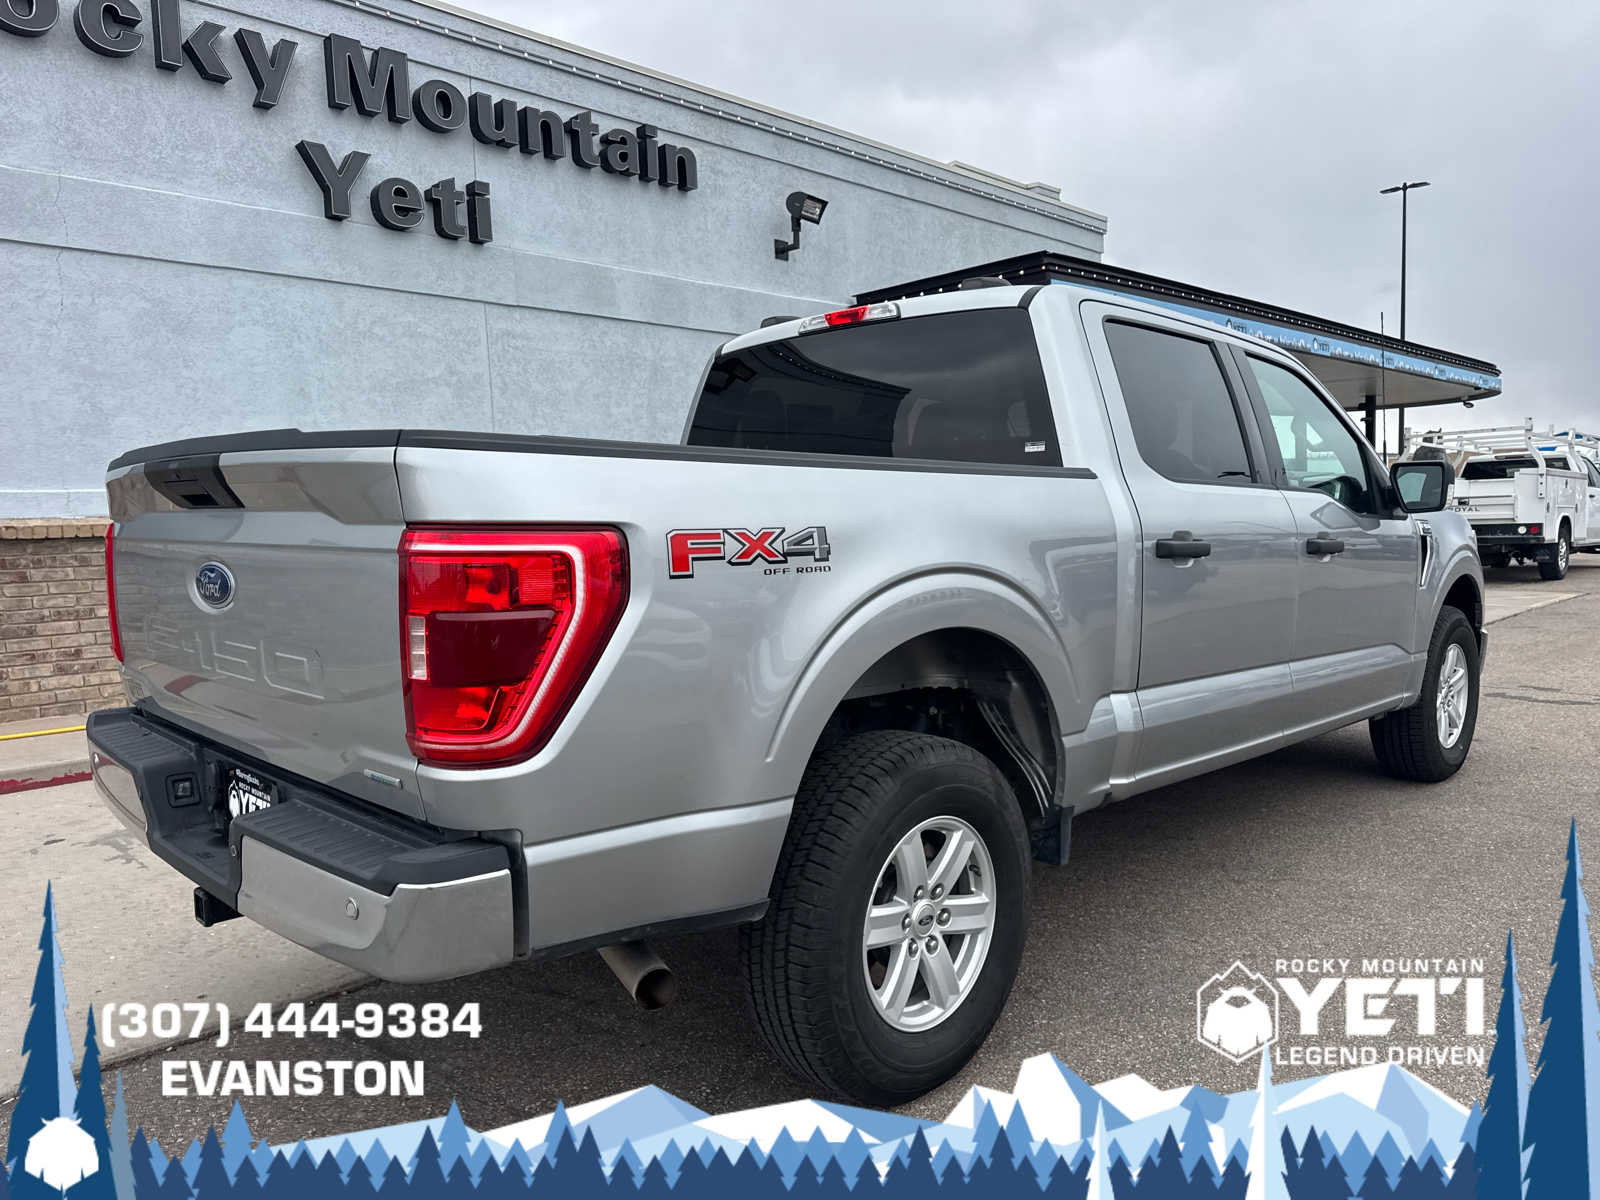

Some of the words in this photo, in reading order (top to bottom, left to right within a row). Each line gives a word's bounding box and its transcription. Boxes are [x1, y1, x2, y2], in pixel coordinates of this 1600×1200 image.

[323, 33, 699, 191] Mountain
[295, 139, 493, 244] Yeti
[666, 527, 831, 579] FX4
[763, 568, 791, 576] OFF
[796, 565, 832, 574] ROAD
[199, 570, 221, 598] Ford
